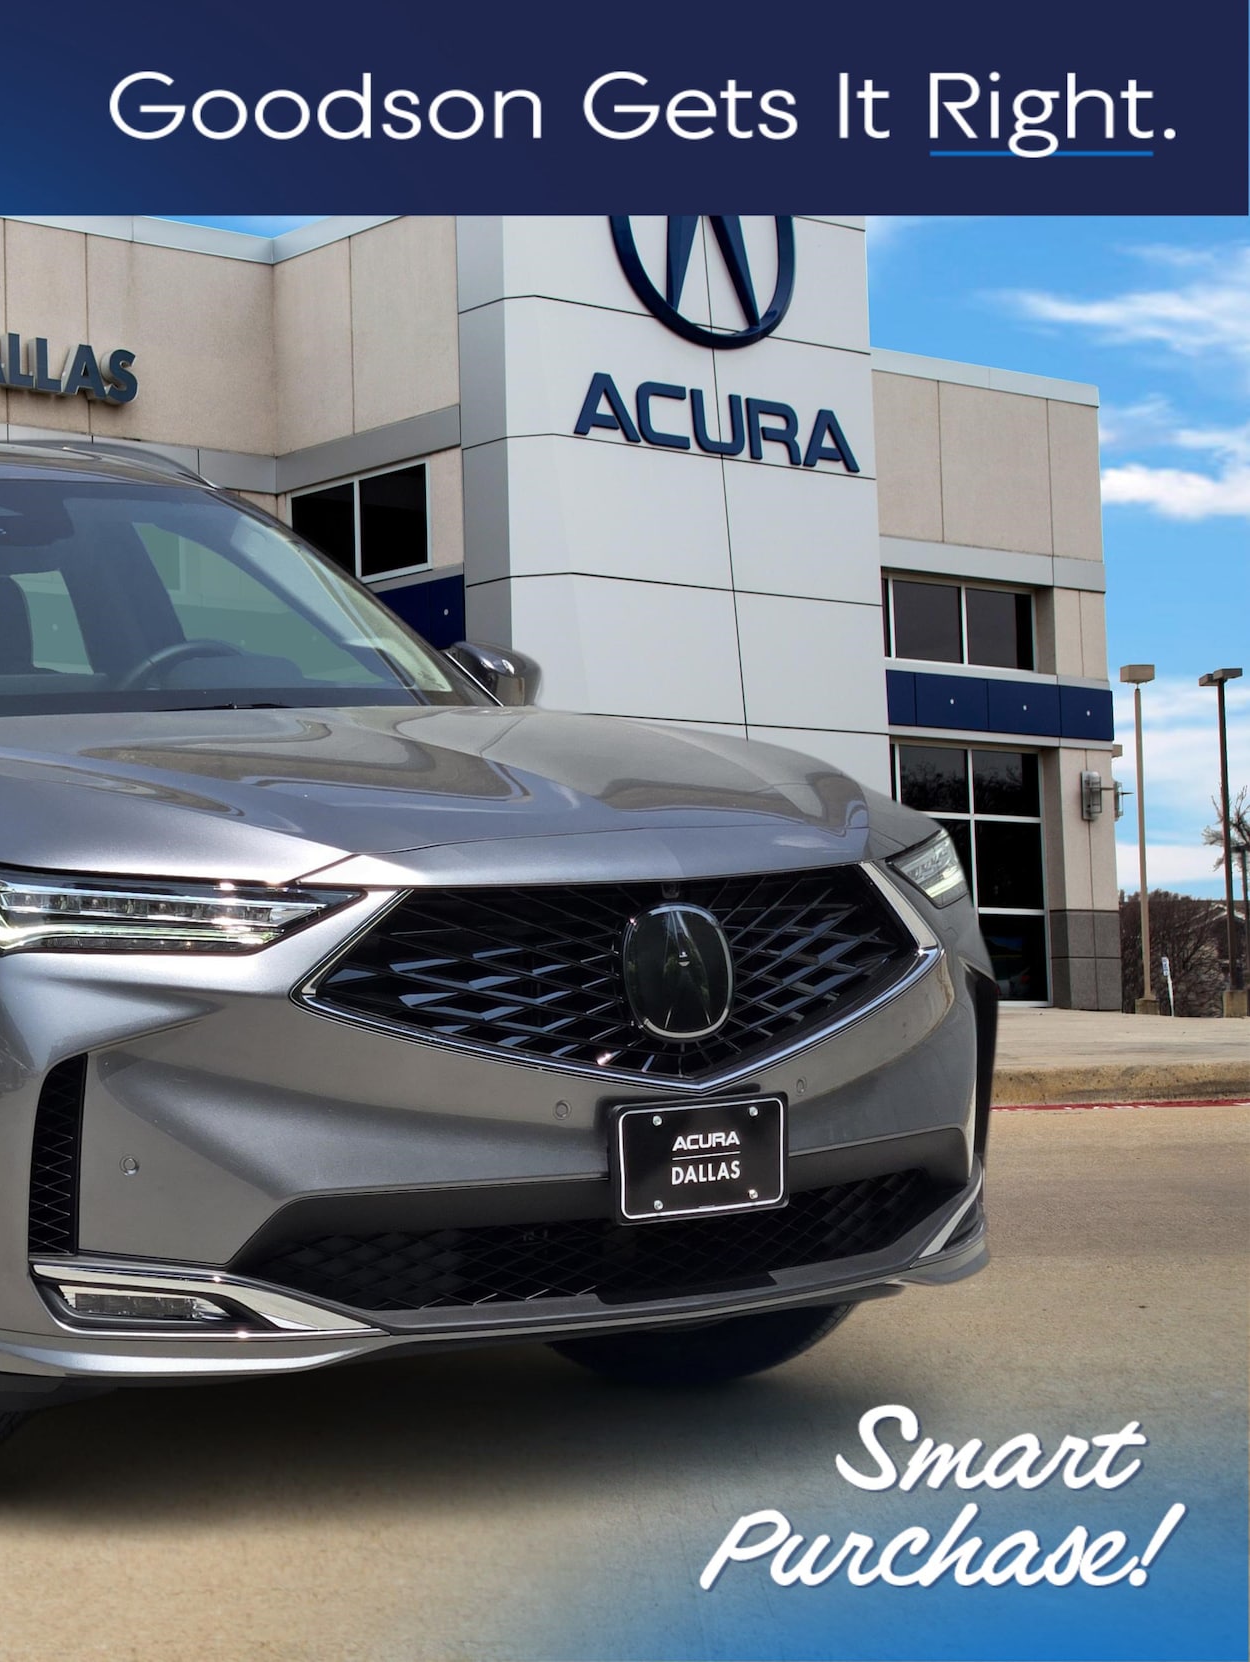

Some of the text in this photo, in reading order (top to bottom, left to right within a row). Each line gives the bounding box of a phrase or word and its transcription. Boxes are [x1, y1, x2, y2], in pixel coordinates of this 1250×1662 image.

[573, 372, 861, 473] ACURA
[671, 1130, 741, 1153] ACURA
[671, 1160, 741, 1186] DALLAS
